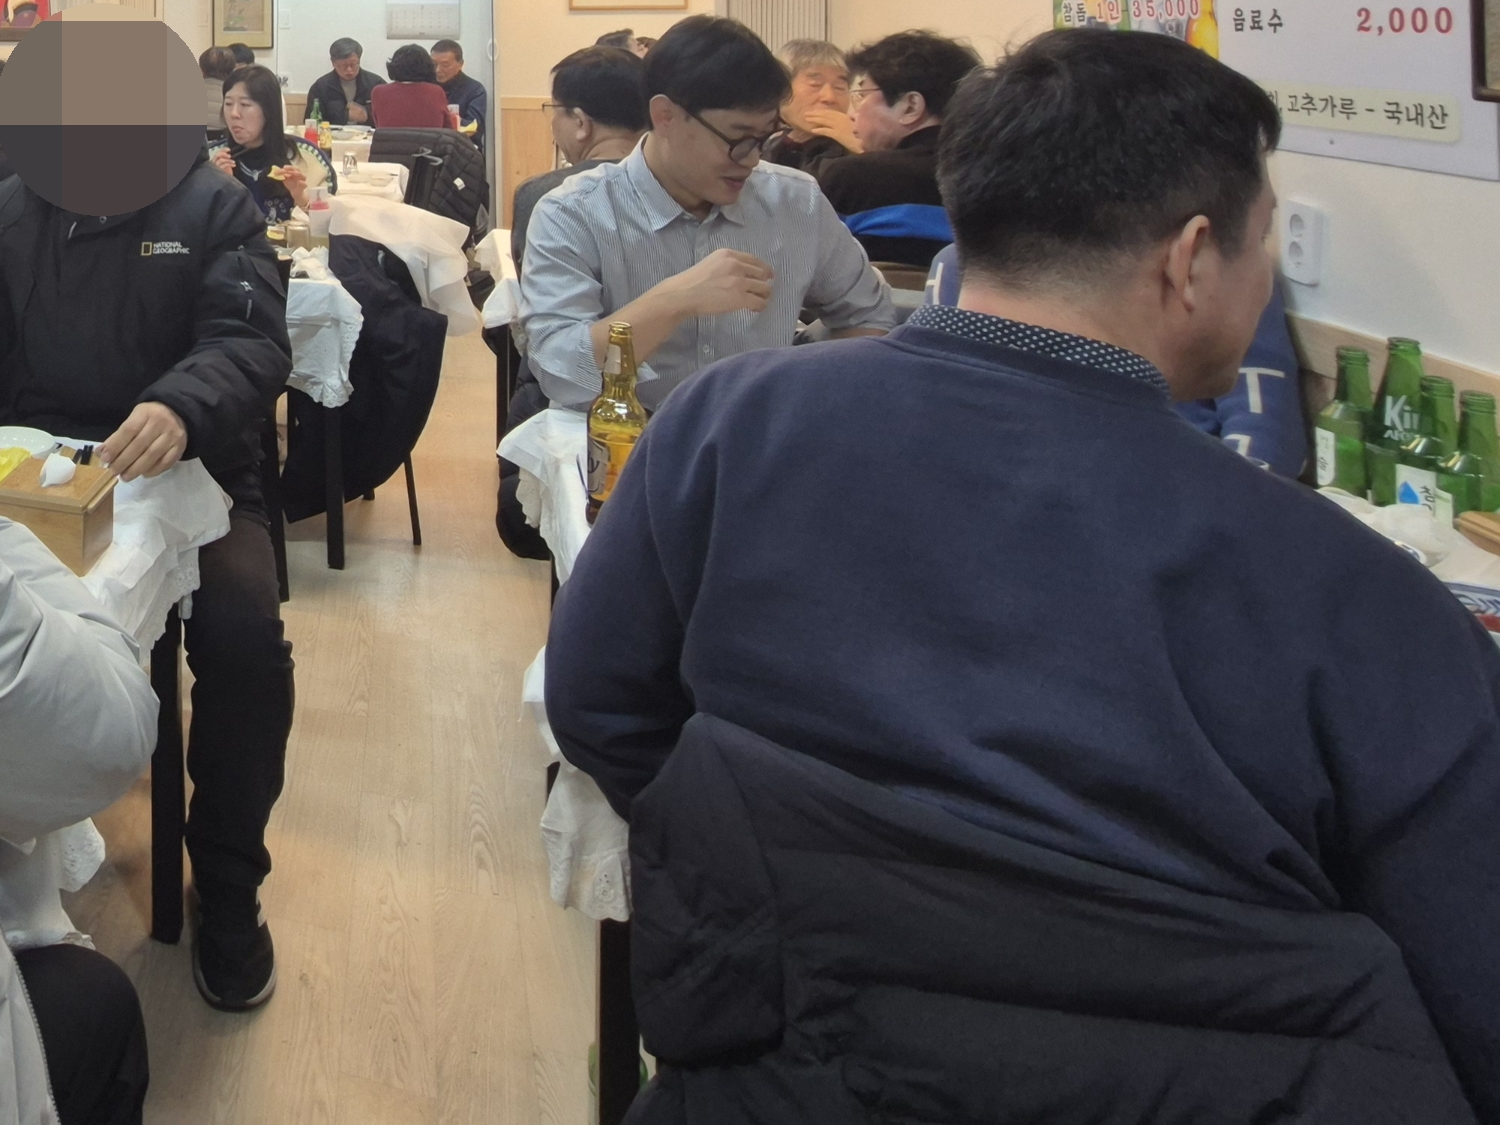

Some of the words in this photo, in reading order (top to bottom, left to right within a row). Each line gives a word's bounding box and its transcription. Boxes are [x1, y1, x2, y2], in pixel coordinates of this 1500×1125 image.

[1062, 2, 1086, 23] 참돔
[1232, 8, 1283, 33] 음료수
[1357, 6, 1453, 36] 2,000
[1287, 92, 1358, 120] 고추가루
[1383, 101, 1448, 130] 국내산
